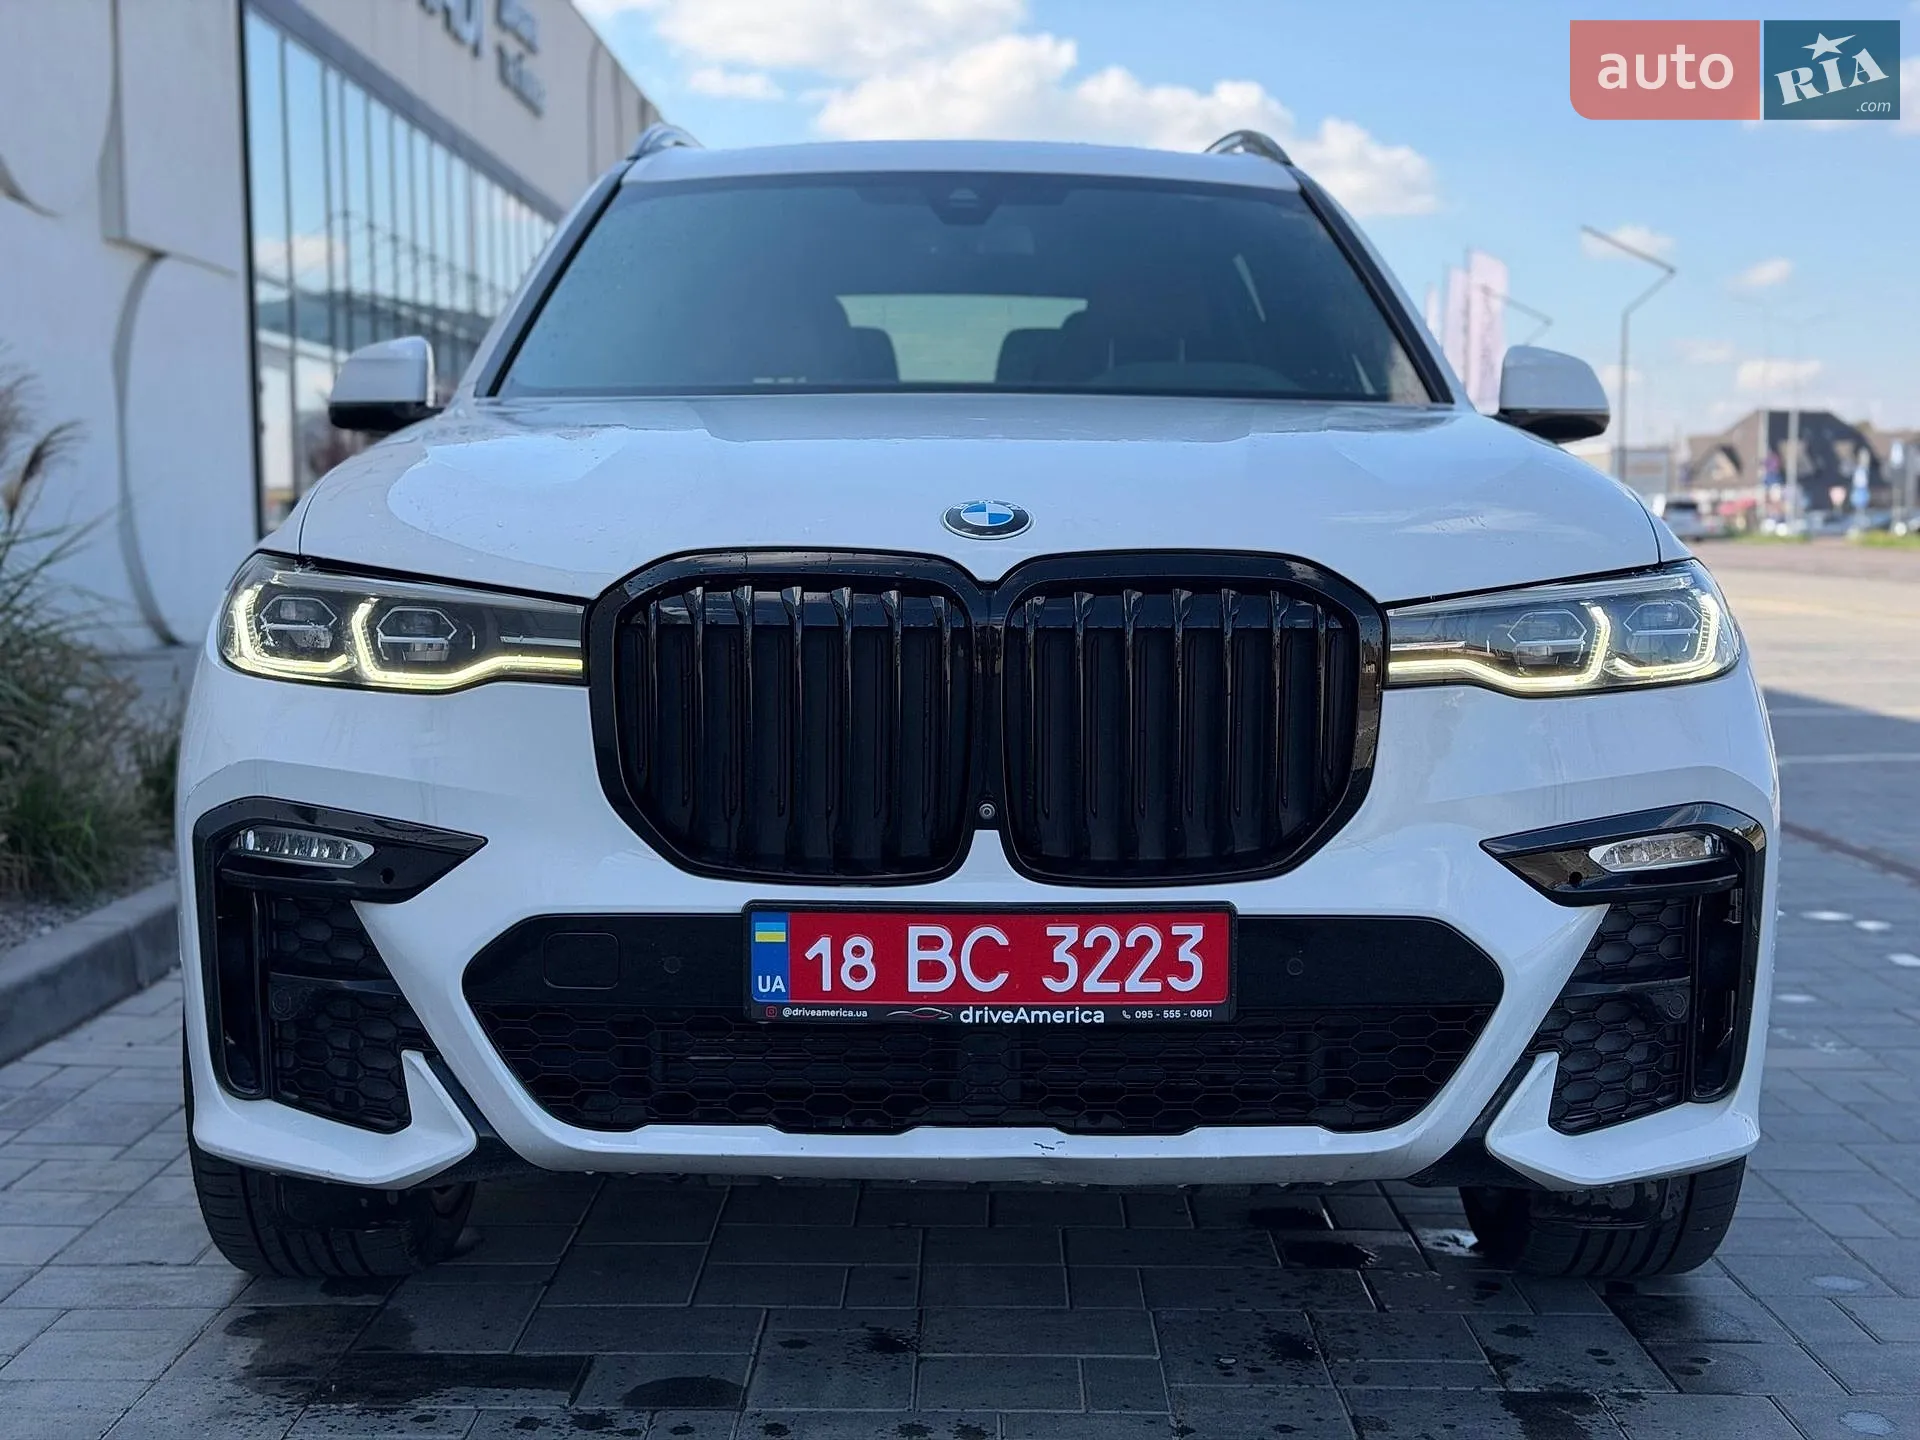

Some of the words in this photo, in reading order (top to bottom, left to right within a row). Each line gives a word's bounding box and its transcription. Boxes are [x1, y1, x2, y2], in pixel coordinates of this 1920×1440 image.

[804, 936, 876, 991] 18
[907, 926, 1009, 992] BC
[1042, 925, 1205, 992] 3223
[757, 976, 786, 993] UA
[782, 1007, 868, 1018] @driveamerica.ua
[959, 1006, 1105, 1024] driveAmerica
[1135, 1010, 1154, 1019] 095
[1163, 1010, 1181, 1018] 555
[1190, 1009, 1212, 1018] 0801
